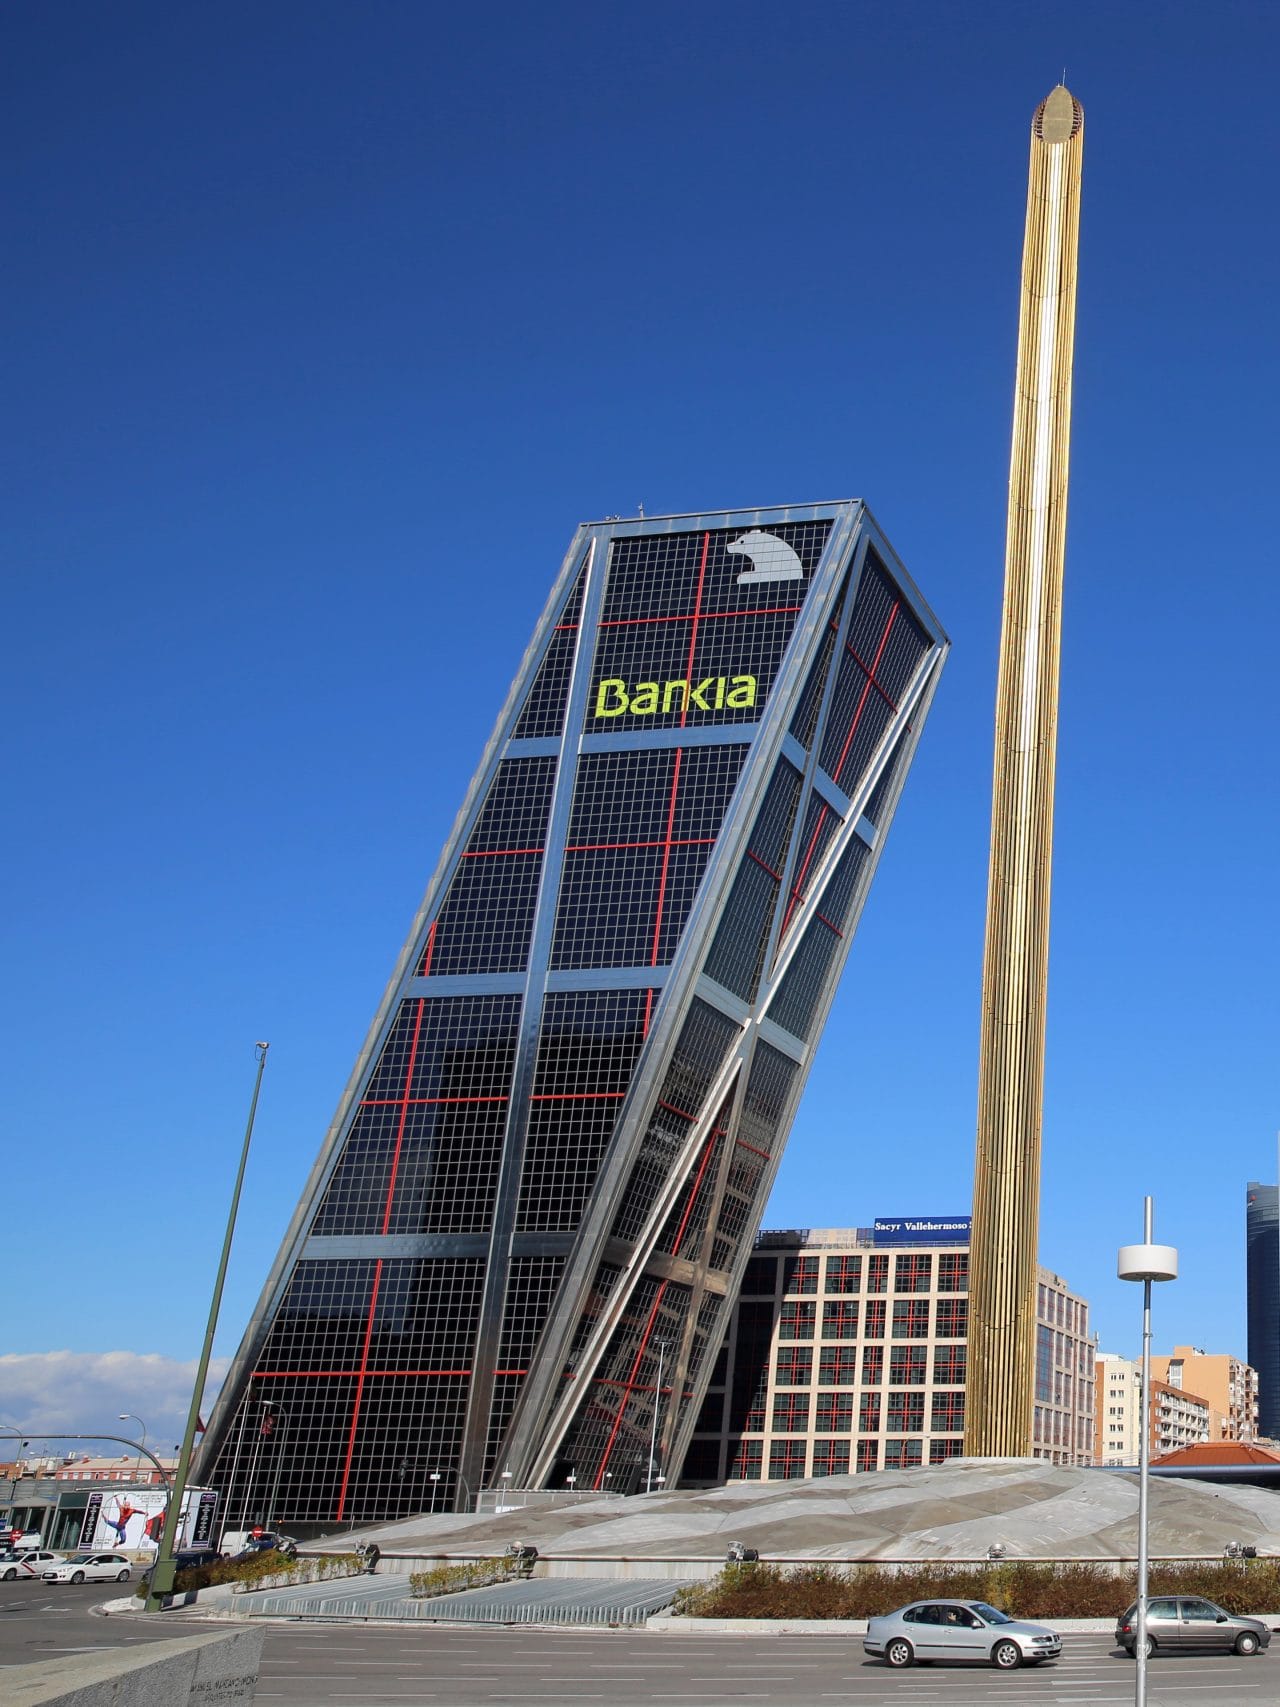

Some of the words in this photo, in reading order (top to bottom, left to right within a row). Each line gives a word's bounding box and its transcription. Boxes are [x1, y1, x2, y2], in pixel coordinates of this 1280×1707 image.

[595, 675, 757, 718] Bankia
[875, 1222, 901, 1232] Sacyr
[905, 1222, 967, 1231] Vallehermoso
